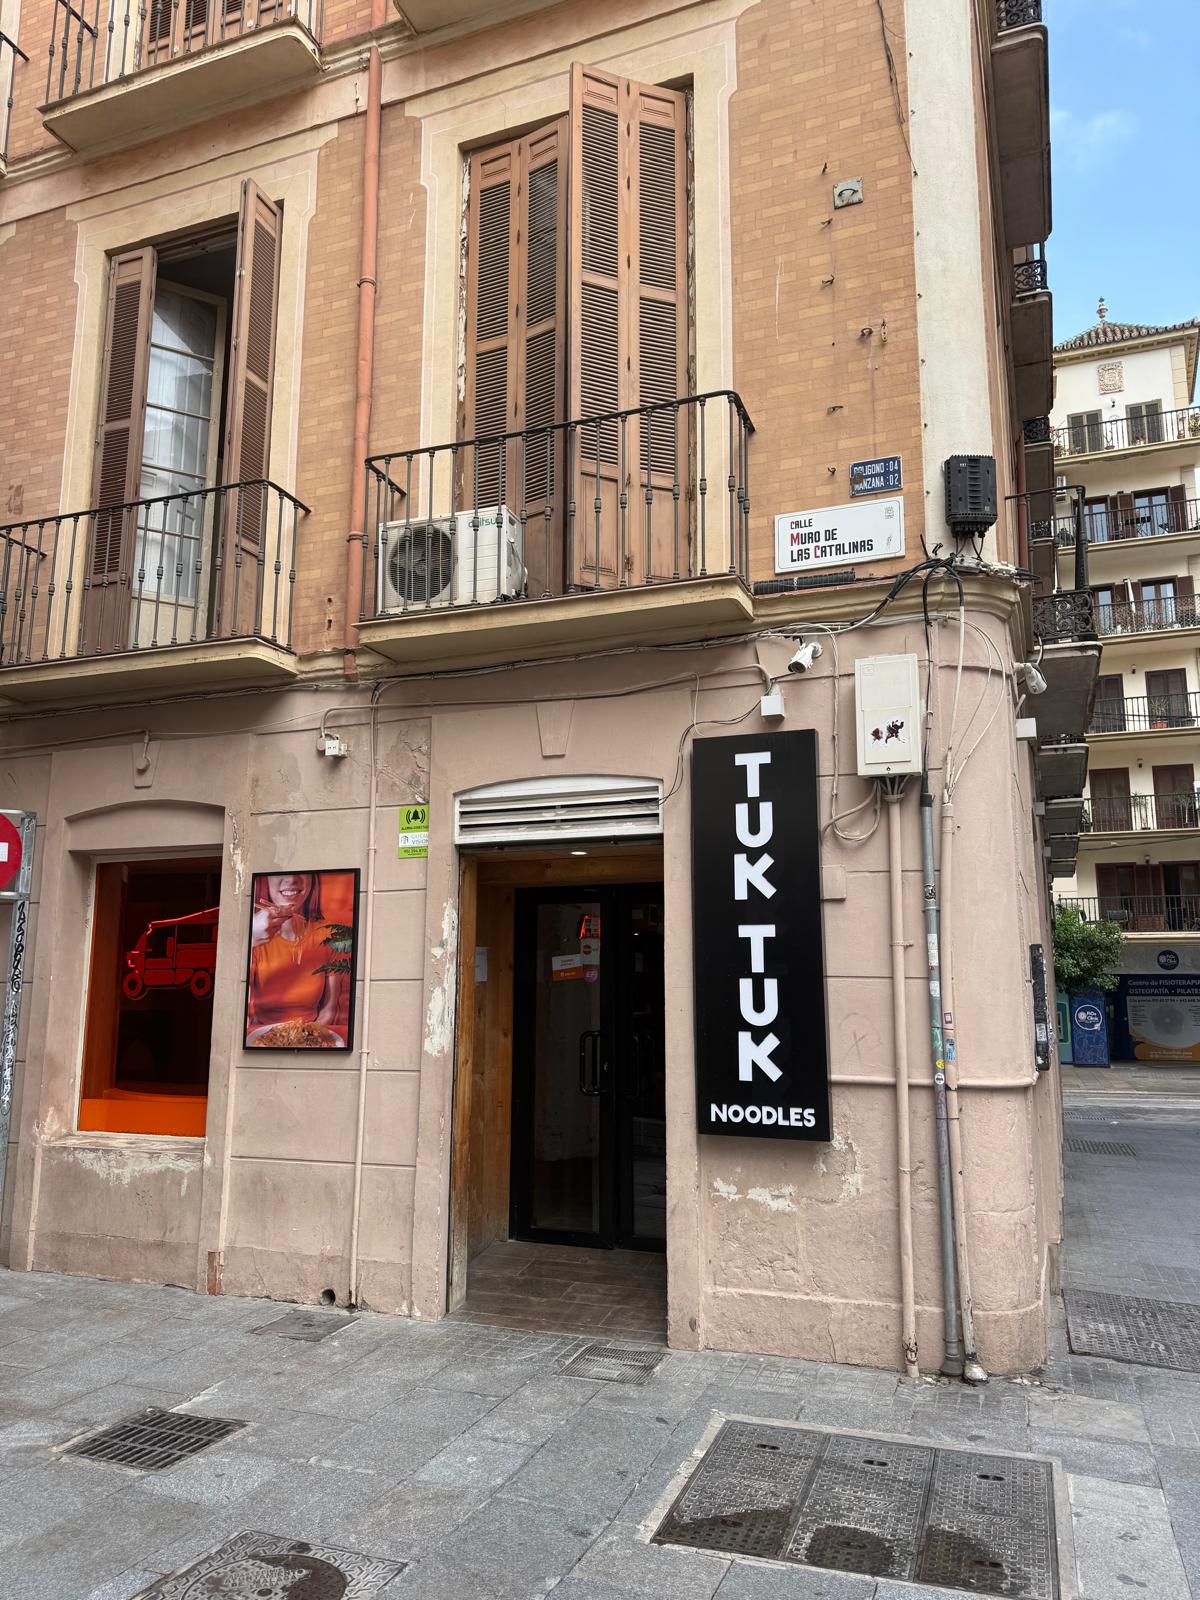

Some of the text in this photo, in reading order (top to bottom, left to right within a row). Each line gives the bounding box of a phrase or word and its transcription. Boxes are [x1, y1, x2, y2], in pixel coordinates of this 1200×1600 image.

[791, 518, 813, 529] CALLE
[791, 528, 838, 546] MURO DE
[791, 539, 874, 562] LAS CATALINAS
[734, 751, 783, 1083] TUK TUK
[710, 1103, 815, 1128] NOODLES
